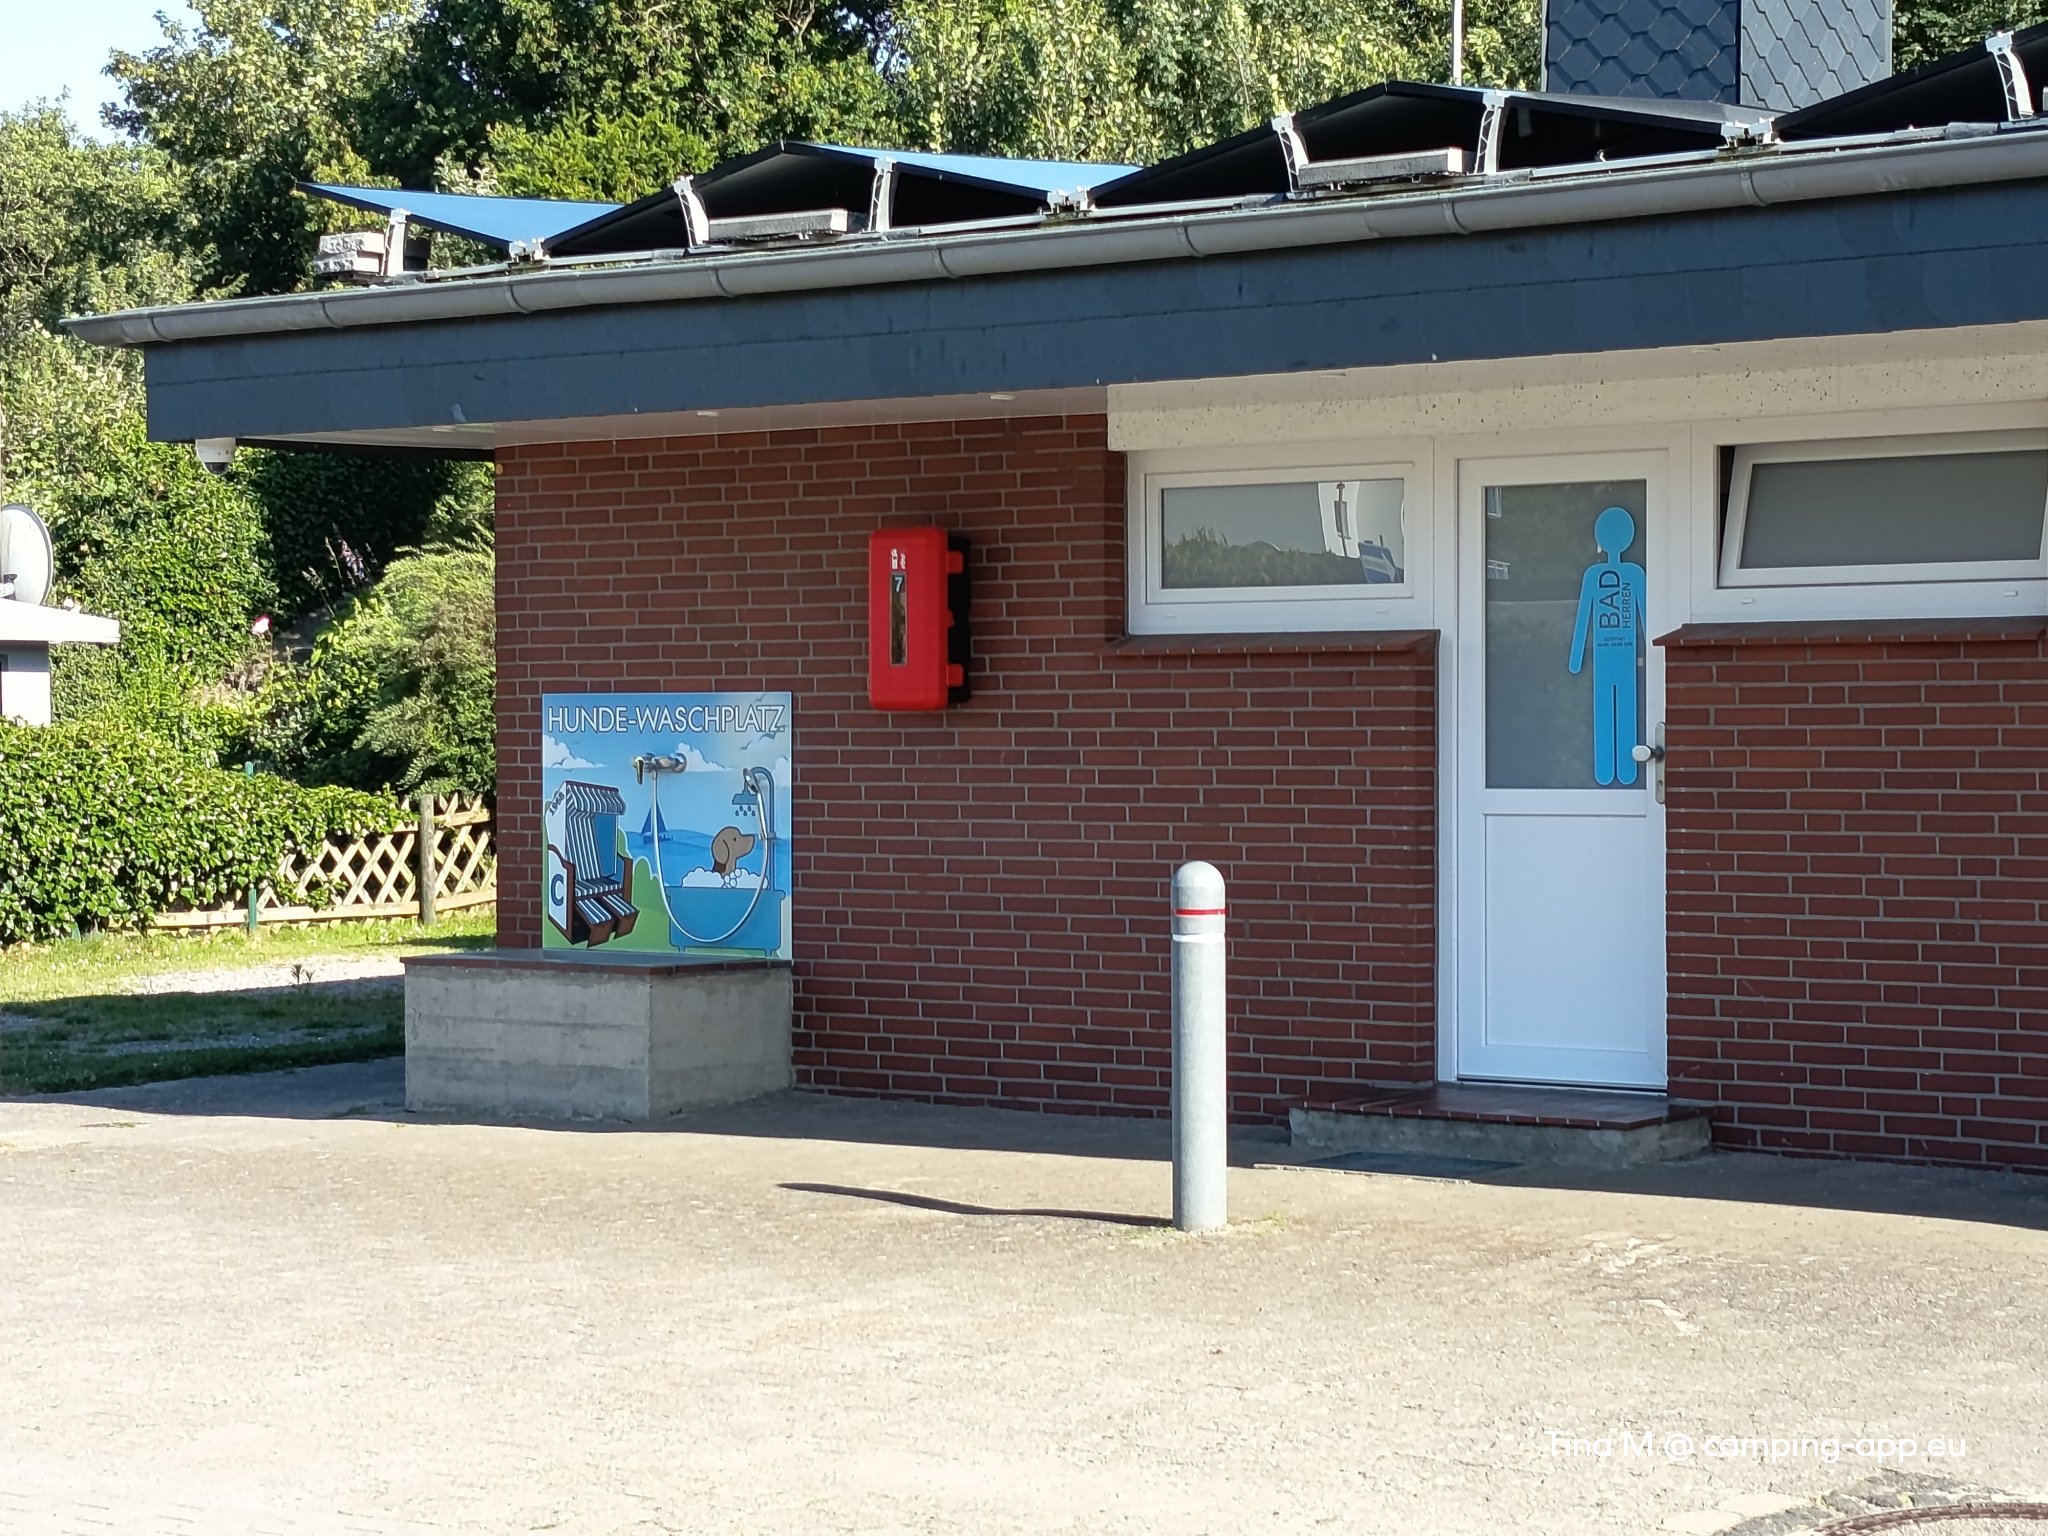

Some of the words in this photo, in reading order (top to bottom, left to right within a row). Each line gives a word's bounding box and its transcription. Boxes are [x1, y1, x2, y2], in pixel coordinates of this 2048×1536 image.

[894, 576, 903, 593] 7
[1598, 570, 1620, 629] BAD
[1621, 582, 1631, 629] HERREN
[547, 705, 785, 733] HUNDE-WASCHPLATZ
[551, 873, 564, 906] C
